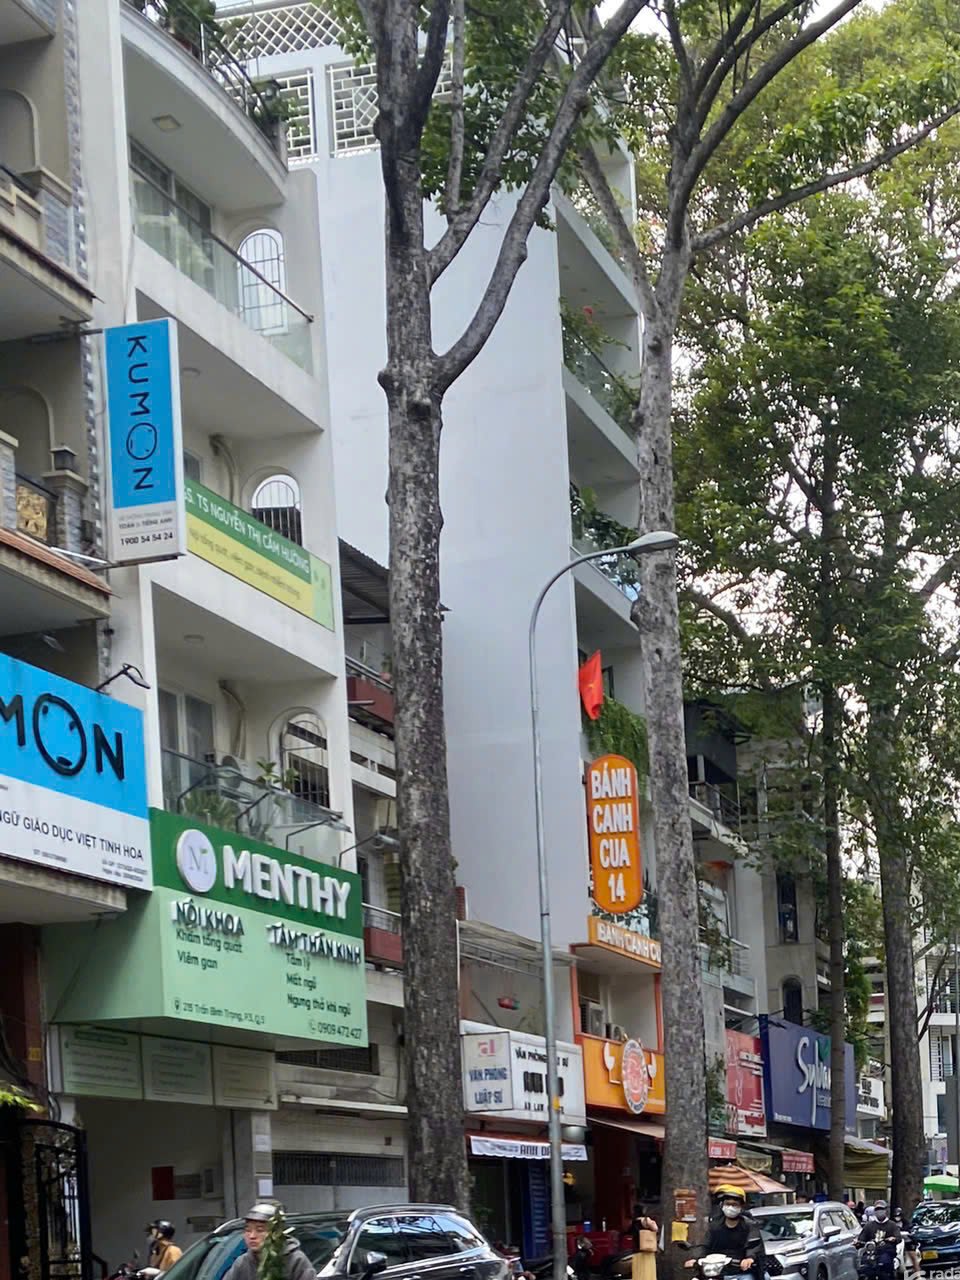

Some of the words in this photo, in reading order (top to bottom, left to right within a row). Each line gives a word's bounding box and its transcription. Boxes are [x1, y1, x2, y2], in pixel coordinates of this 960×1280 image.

[126, 335, 158, 491] KUMON
[121, 536, 139, 546] 1900
[141, 535, 150, 543] 54
[152, 533, 162, 541] 54
[164, 532, 173, 540] 24
[591, 762, 631, 800] BÁNH
[592, 802, 633, 834] CANH
[0, 810, 21, 827] GỮ
[23, 816, 50, 836] GIÁO
[51, 824, 74, 843] DỤC
[75, 832, 97, 850] VIỆT
[98, 838, 122, 856] TINH
[123, 847, 144, 861] HOA
[599, 838, 631, 869] CUA
[222, 844, 351, 920] MENTHY
[608, 872, 626, 903] 14
[203, 907, 245, 936] KHOA
[335, 940, 361, 965] KINH
[520, 1144, 539, 1157] ANH
